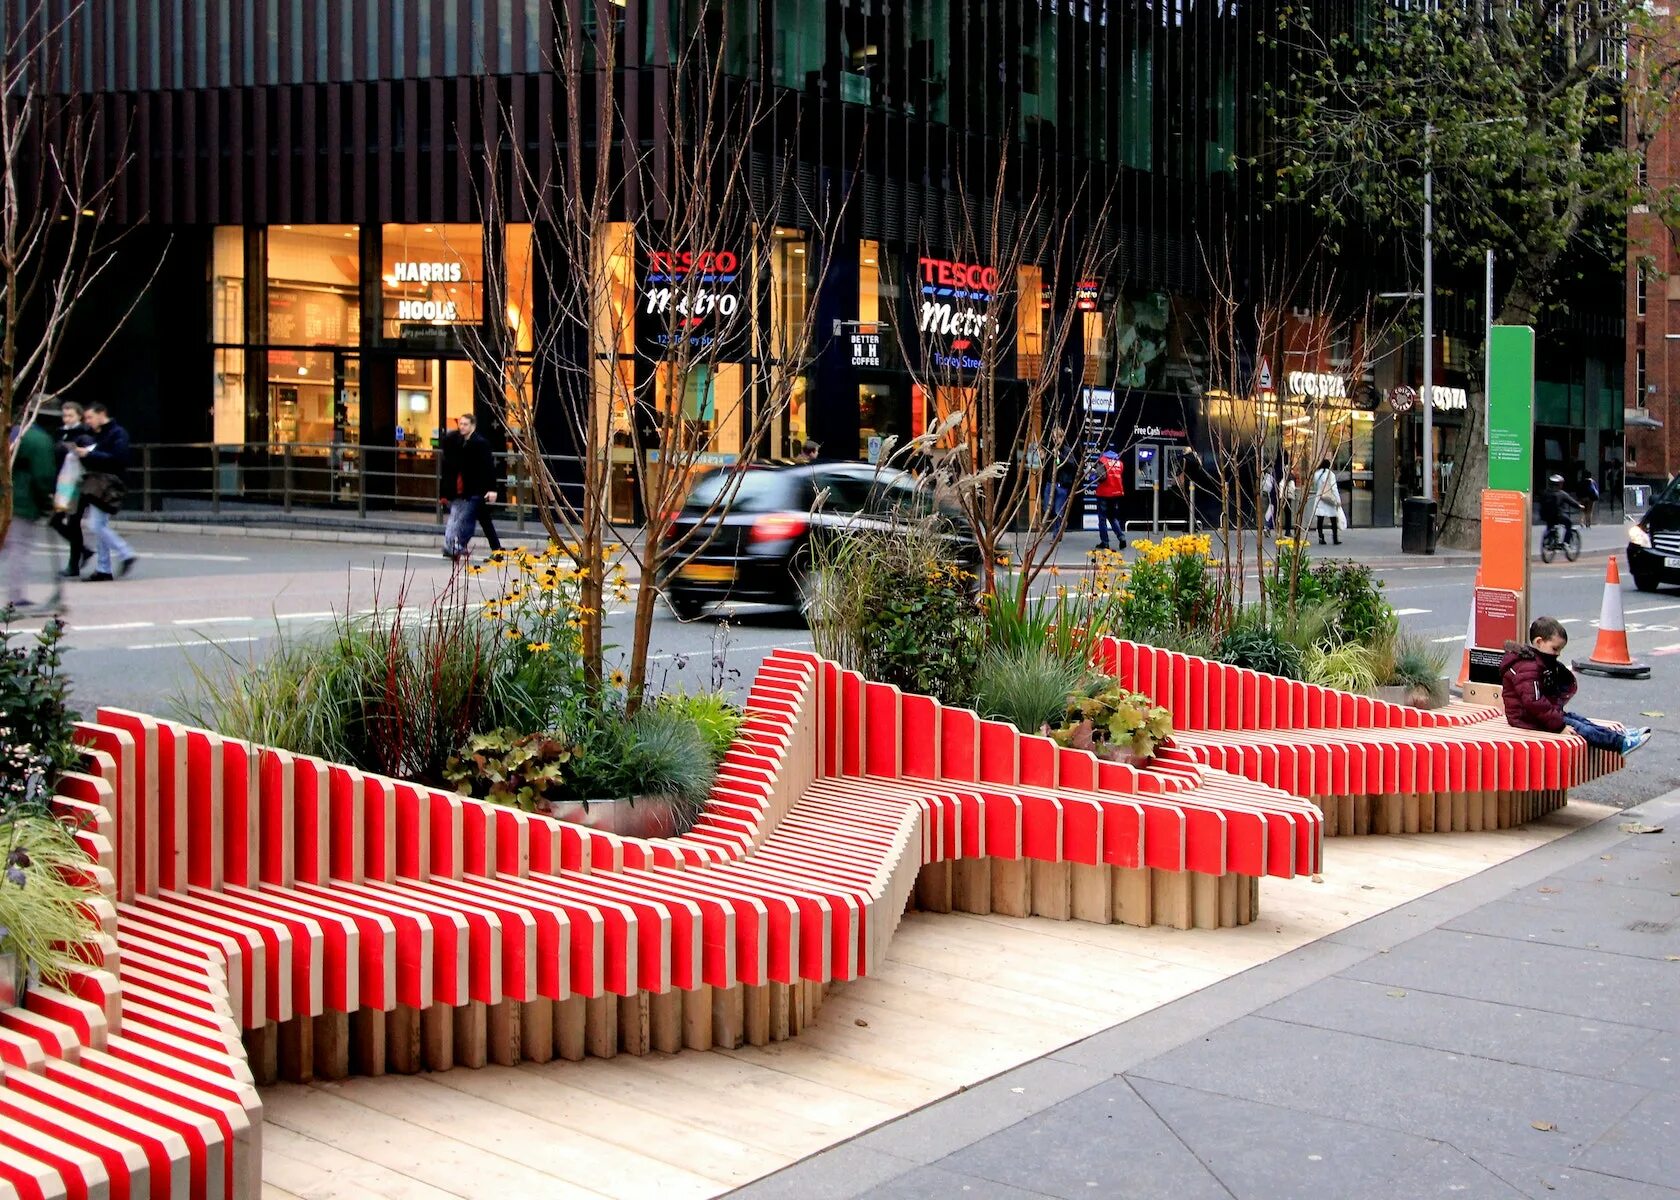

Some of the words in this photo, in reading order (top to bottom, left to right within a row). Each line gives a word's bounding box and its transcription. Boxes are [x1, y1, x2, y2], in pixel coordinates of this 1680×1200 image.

[394, 262, 462, 282] HARRIS
[647, 250, 737, 273] TESCO
[920, 257, 998, 290] TESCO
[646, 287, 737, 316] Metro
[920, 301, 999, 340] Metr
[851, 335, 879, 344] BETTER
[853, 344, 862, 357] H
[868, 344, 877, 357] H
[851, 357, 879, 366] COFFEE
[962, 355, 985, 369] Stree
[1289, 371, 1346, 398] COSTA
